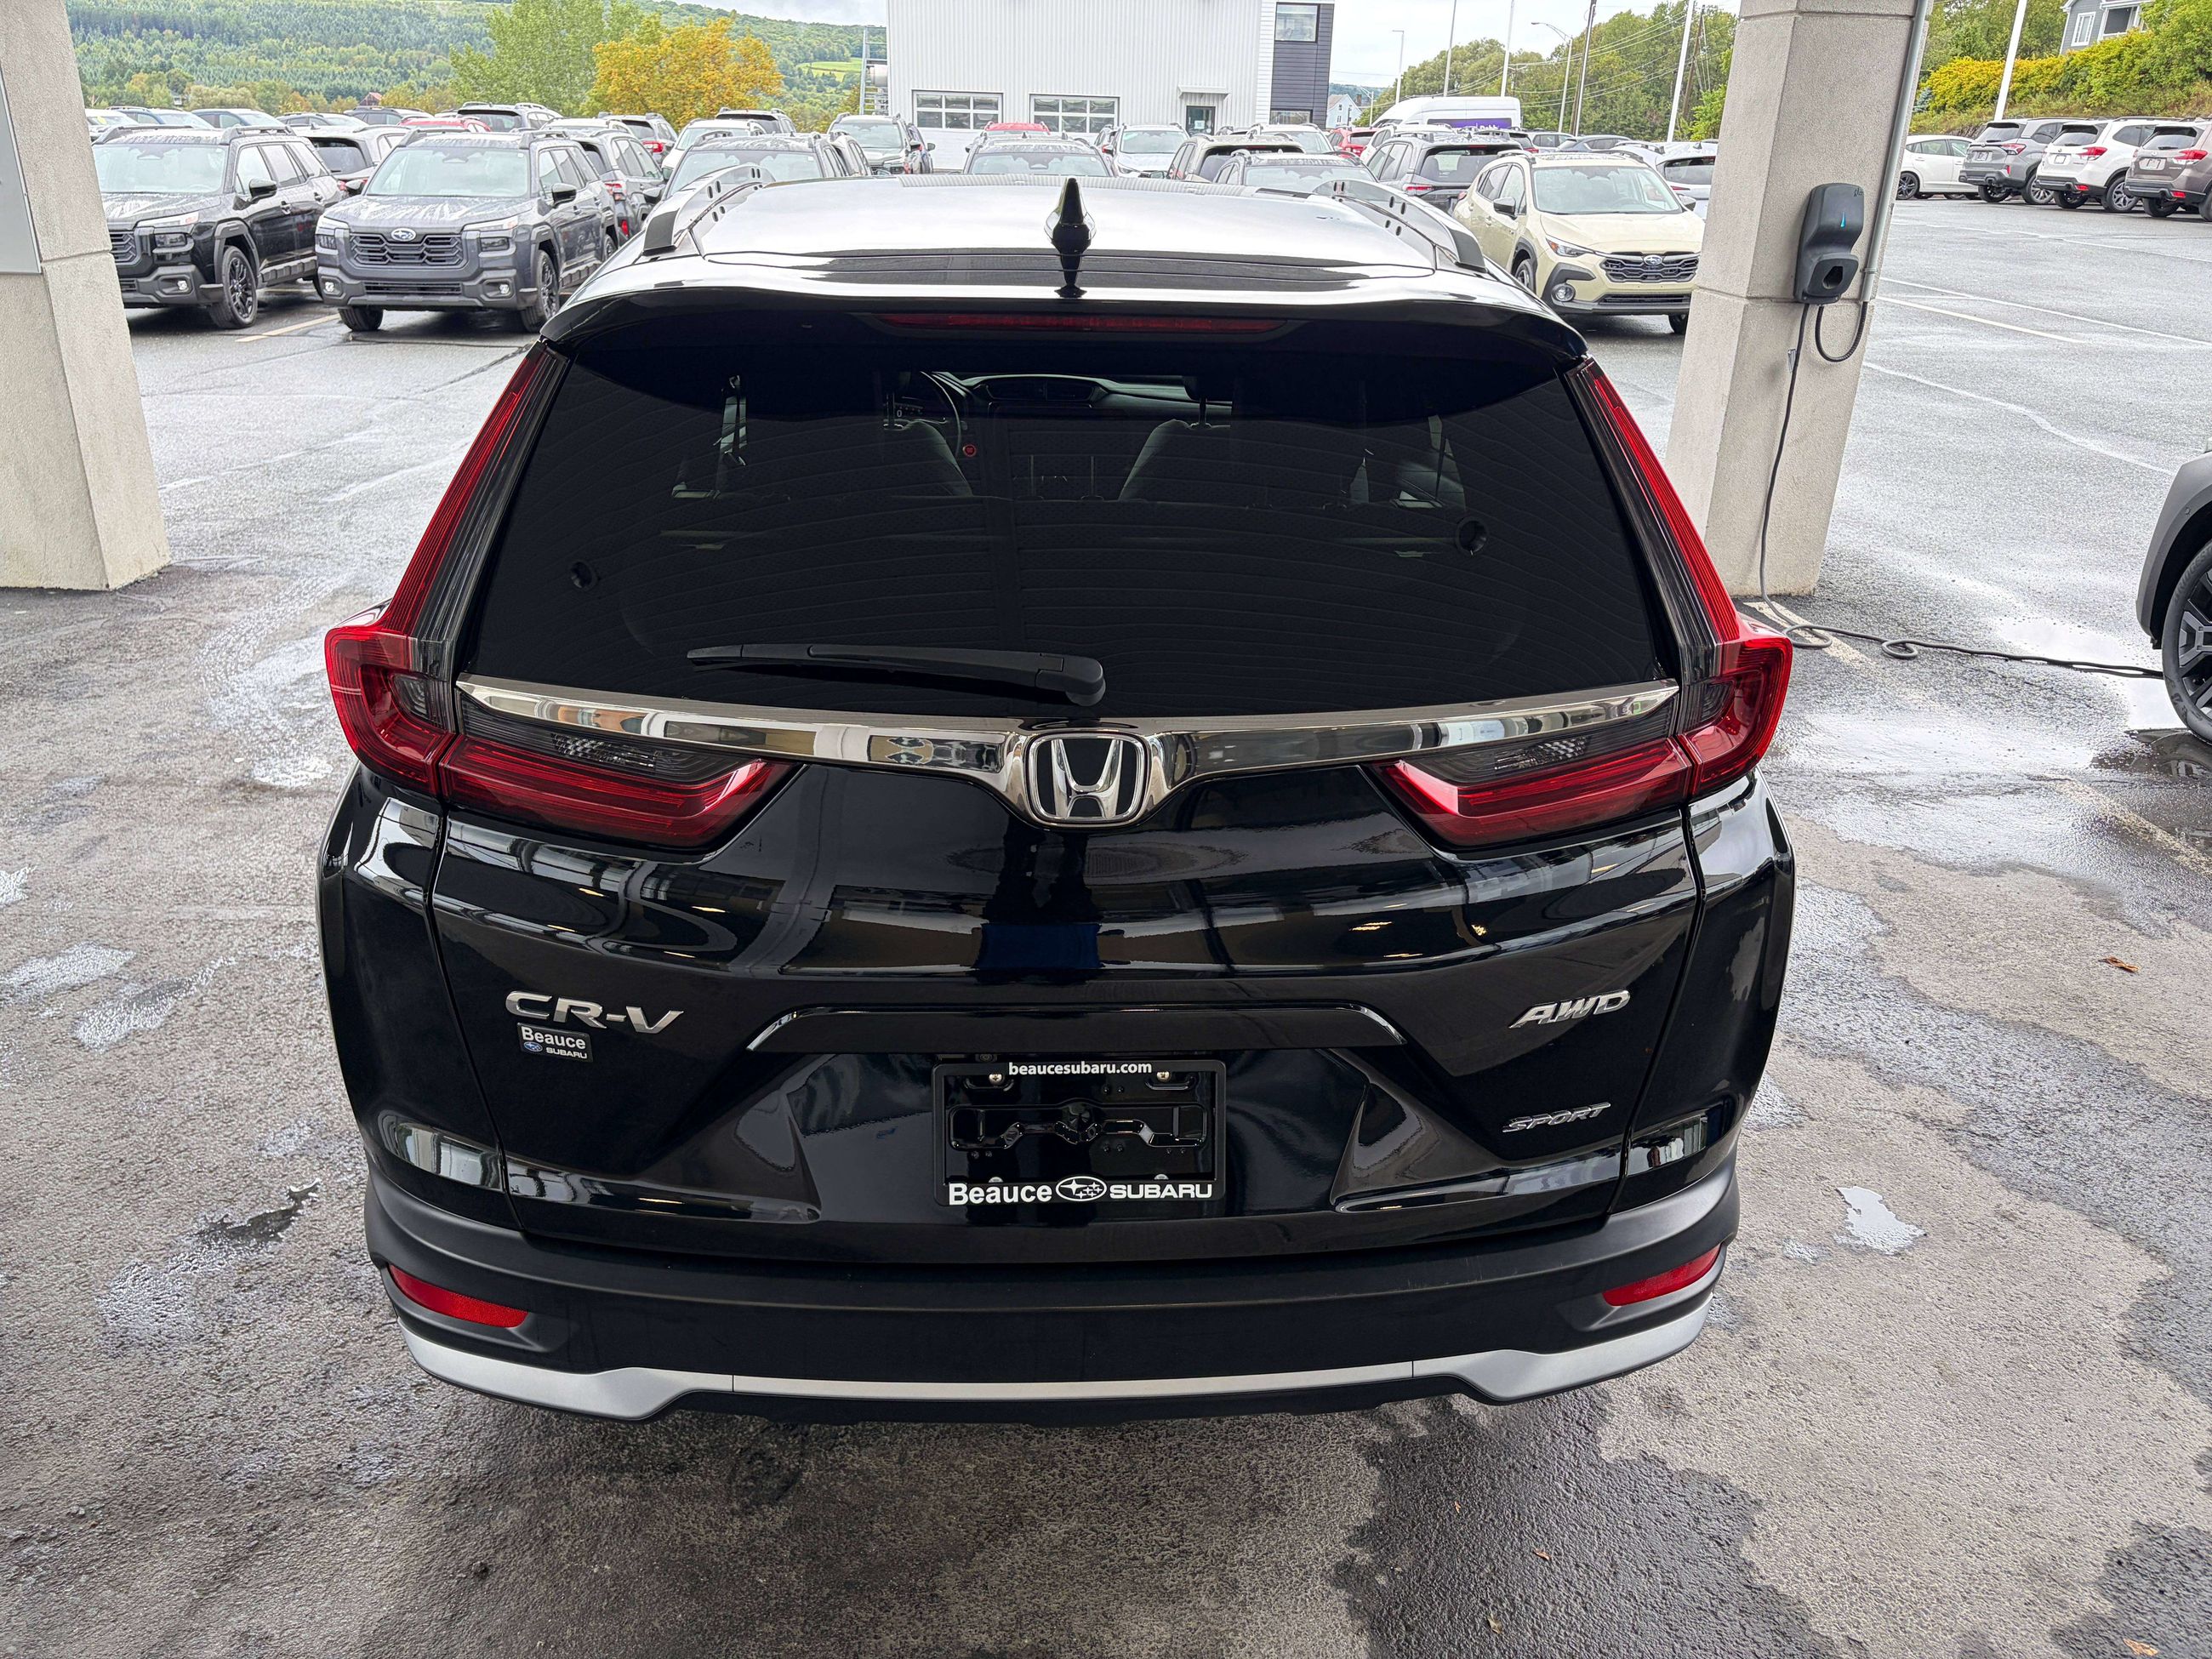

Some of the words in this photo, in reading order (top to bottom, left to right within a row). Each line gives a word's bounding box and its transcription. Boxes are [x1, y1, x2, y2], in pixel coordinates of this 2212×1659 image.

[505, 990, 684, 1034] CR-V
[1508, 989, 1631, 1029] AWD
[521, 1026, 586, 1050] Beauce
[546, 1046, 587, 1059] SUBARU
[1008, 1061, 1152, 1075] beaucesubaru.com
[1502, 1102, 1611, 1133] SPORT
[949, 1183, 1052, 1205] Beauce
[1109, 1183, 1212, 1199] SUBARU
